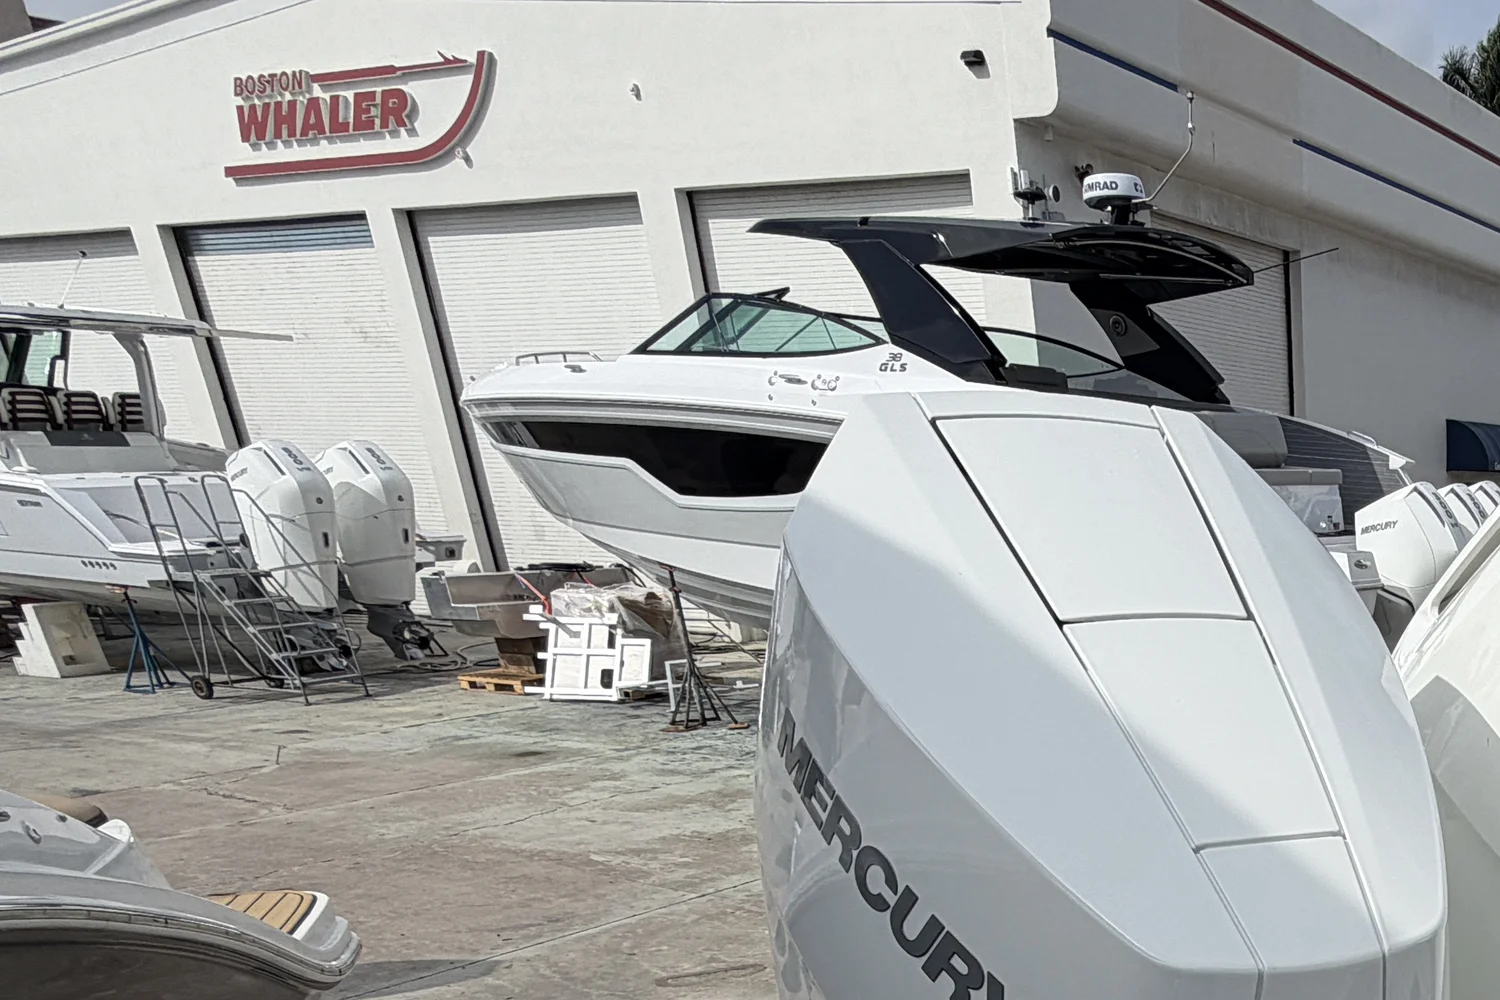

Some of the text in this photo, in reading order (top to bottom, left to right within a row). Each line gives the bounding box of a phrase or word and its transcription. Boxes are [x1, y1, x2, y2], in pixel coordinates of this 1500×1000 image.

[234, 70, 303, 97] BOSTON
[236, 88, 408, 143] WHALER
[879, 362, 908, 373] GLS
[1360, 520, 1398, 536] MERCURY
